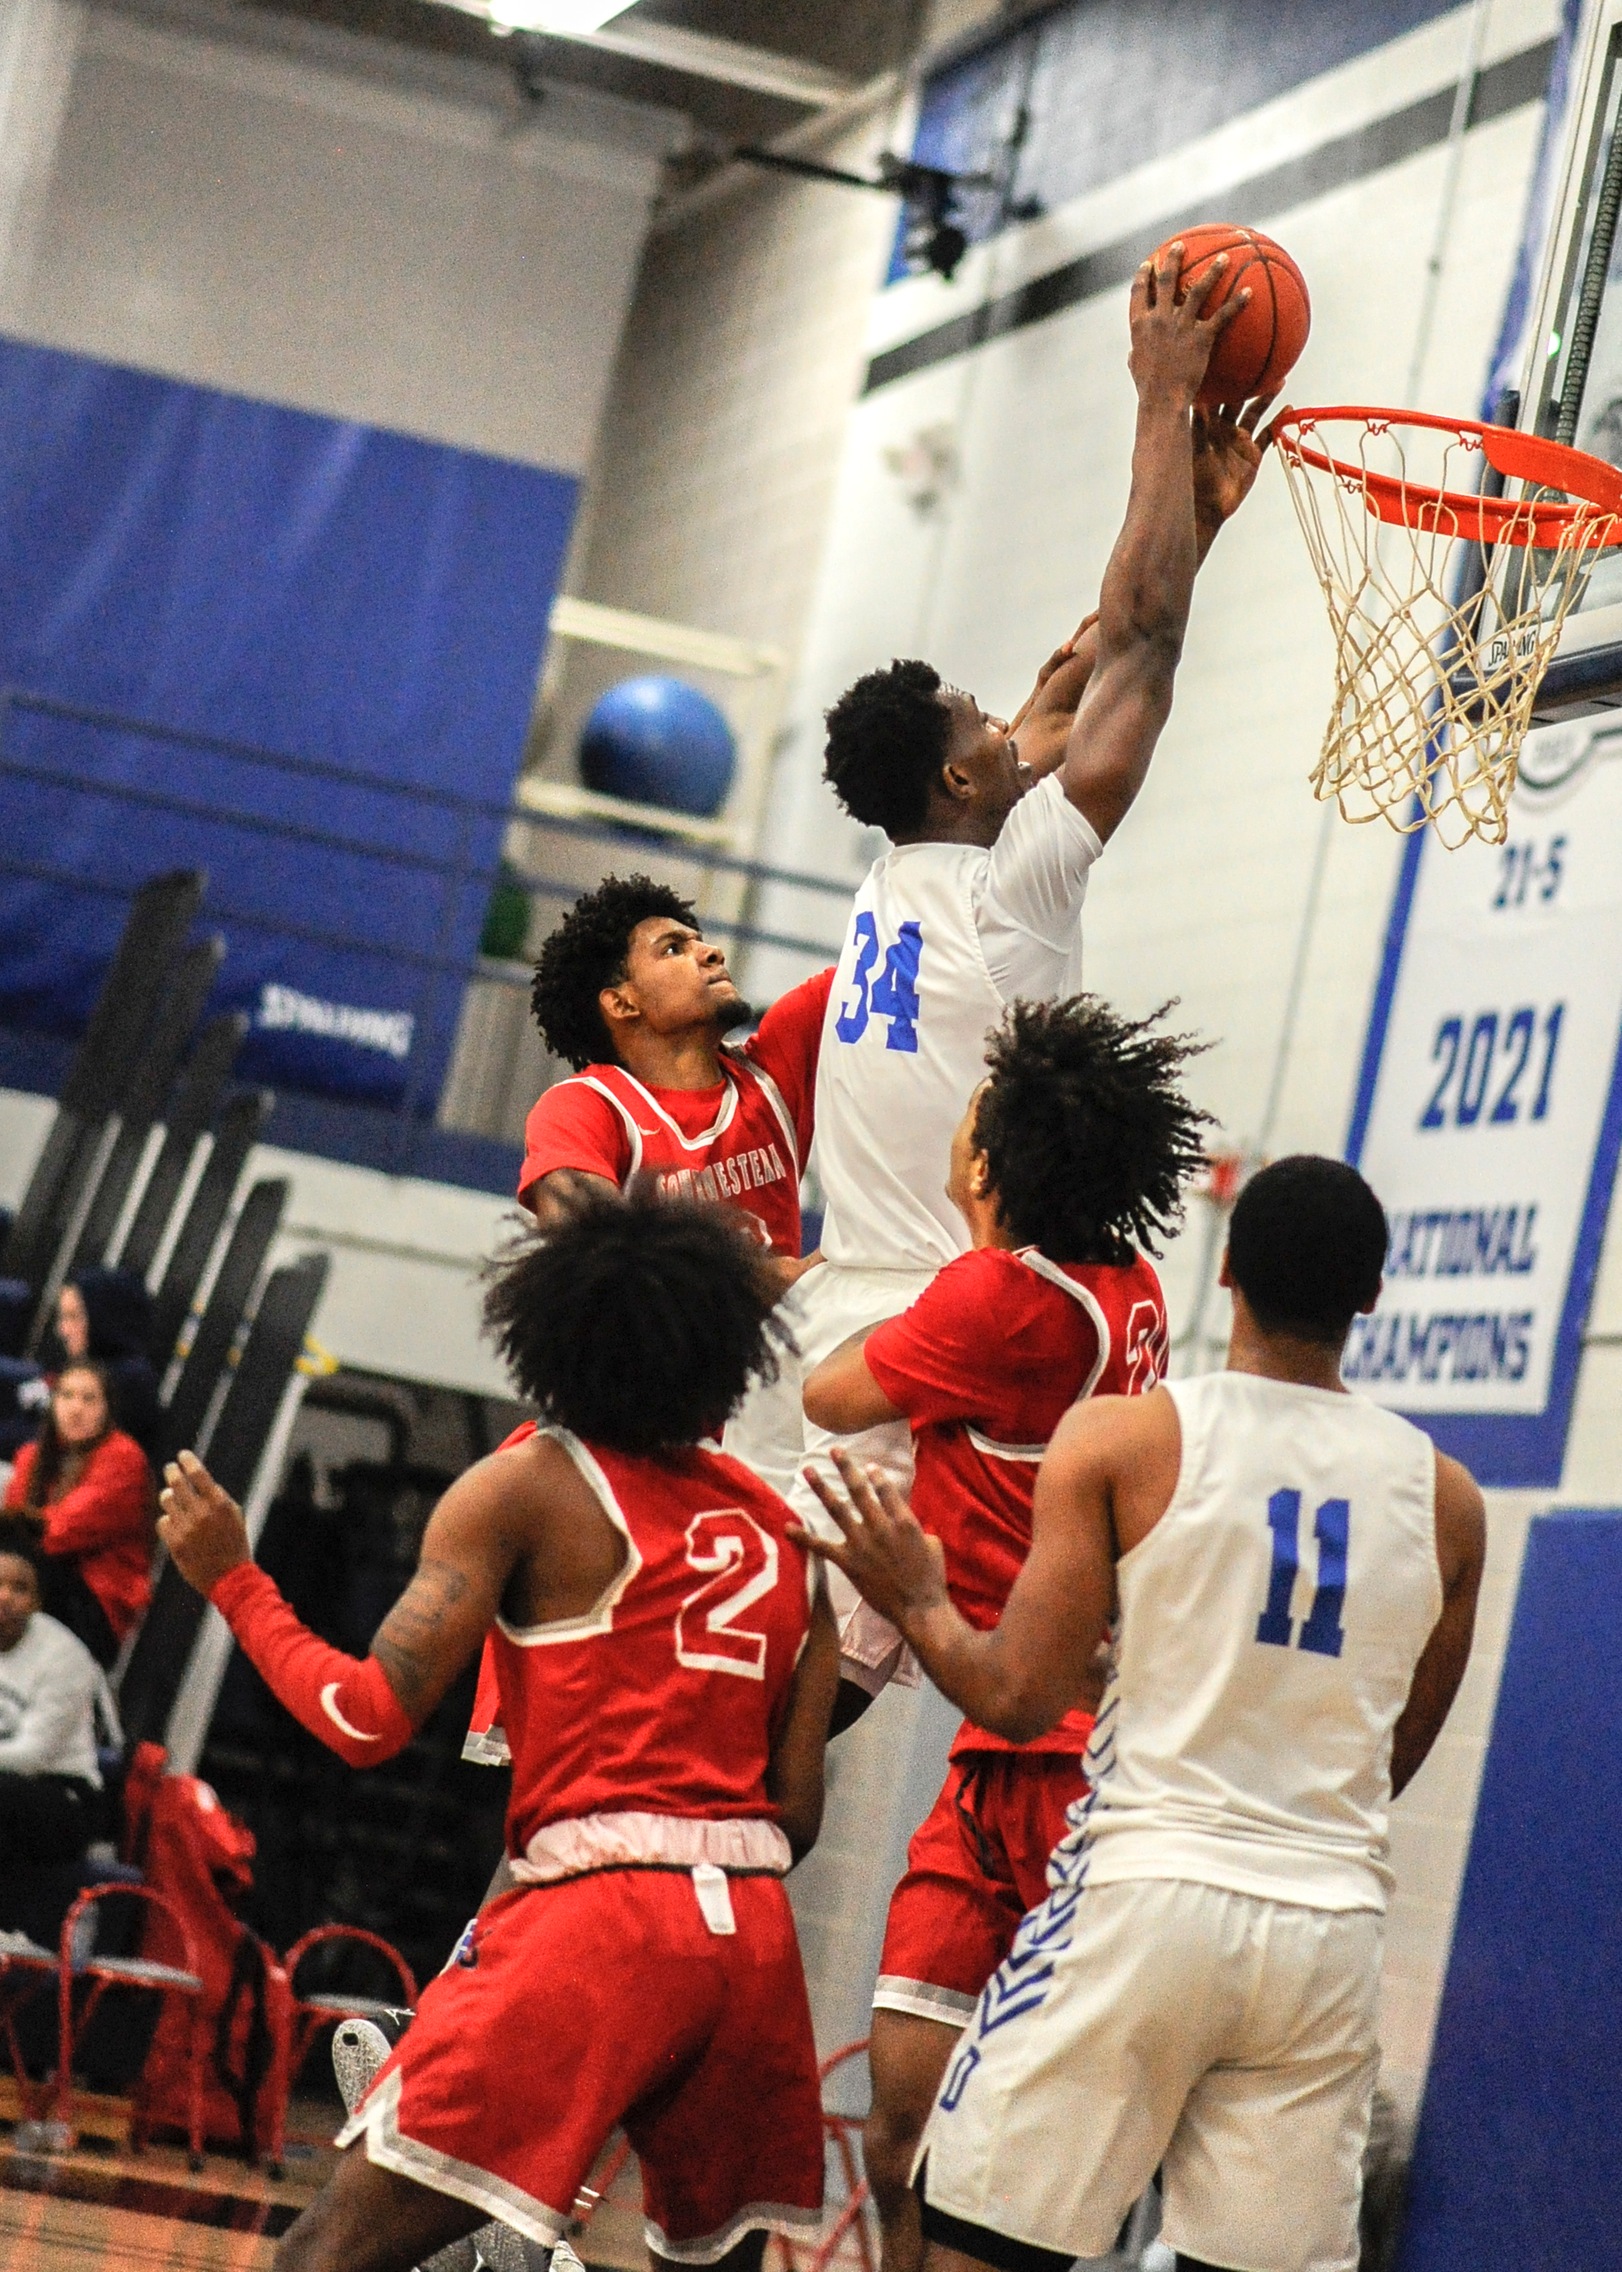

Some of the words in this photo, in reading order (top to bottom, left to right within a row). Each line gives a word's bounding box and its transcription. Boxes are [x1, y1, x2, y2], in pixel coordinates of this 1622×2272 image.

[835, 911, 923, 1053] 34
[1418, 1002, 1565, 1130] 2021
[674, 1508, 778, 1680] 2
[1256, 1487, 1351, 1658] 11
